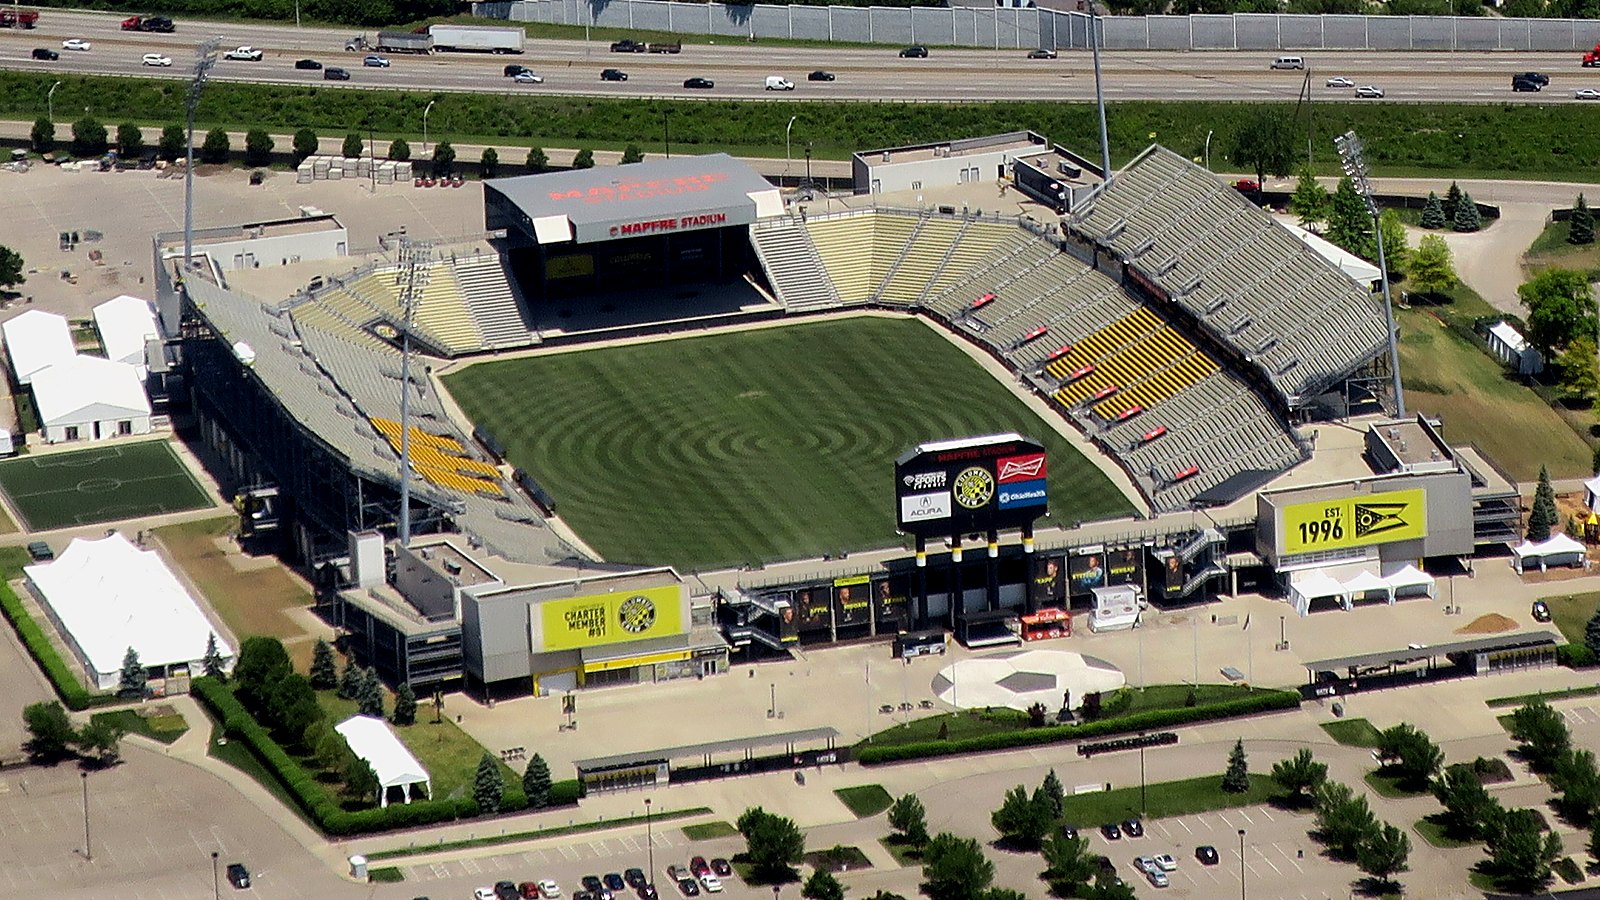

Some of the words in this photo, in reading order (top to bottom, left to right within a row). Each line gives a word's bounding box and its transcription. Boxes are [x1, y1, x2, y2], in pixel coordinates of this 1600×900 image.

[620, 218, 678, 236] MAPFRE
[681, 213, 726, 230] STADIUM
[914, 474, 947, 485] SPORTS
[1010, 490, 1046, 501] OhioHealth
[910, 507, 943, 517] ACURA
[1324, 507, 1344, 519] EST.
[1299, 519, 1344, 544] 1996
[564, 607, 605, 622] CHARTER
[568, 617, 605, 631] MEMBER
[588, 626, 606, 637] #01
